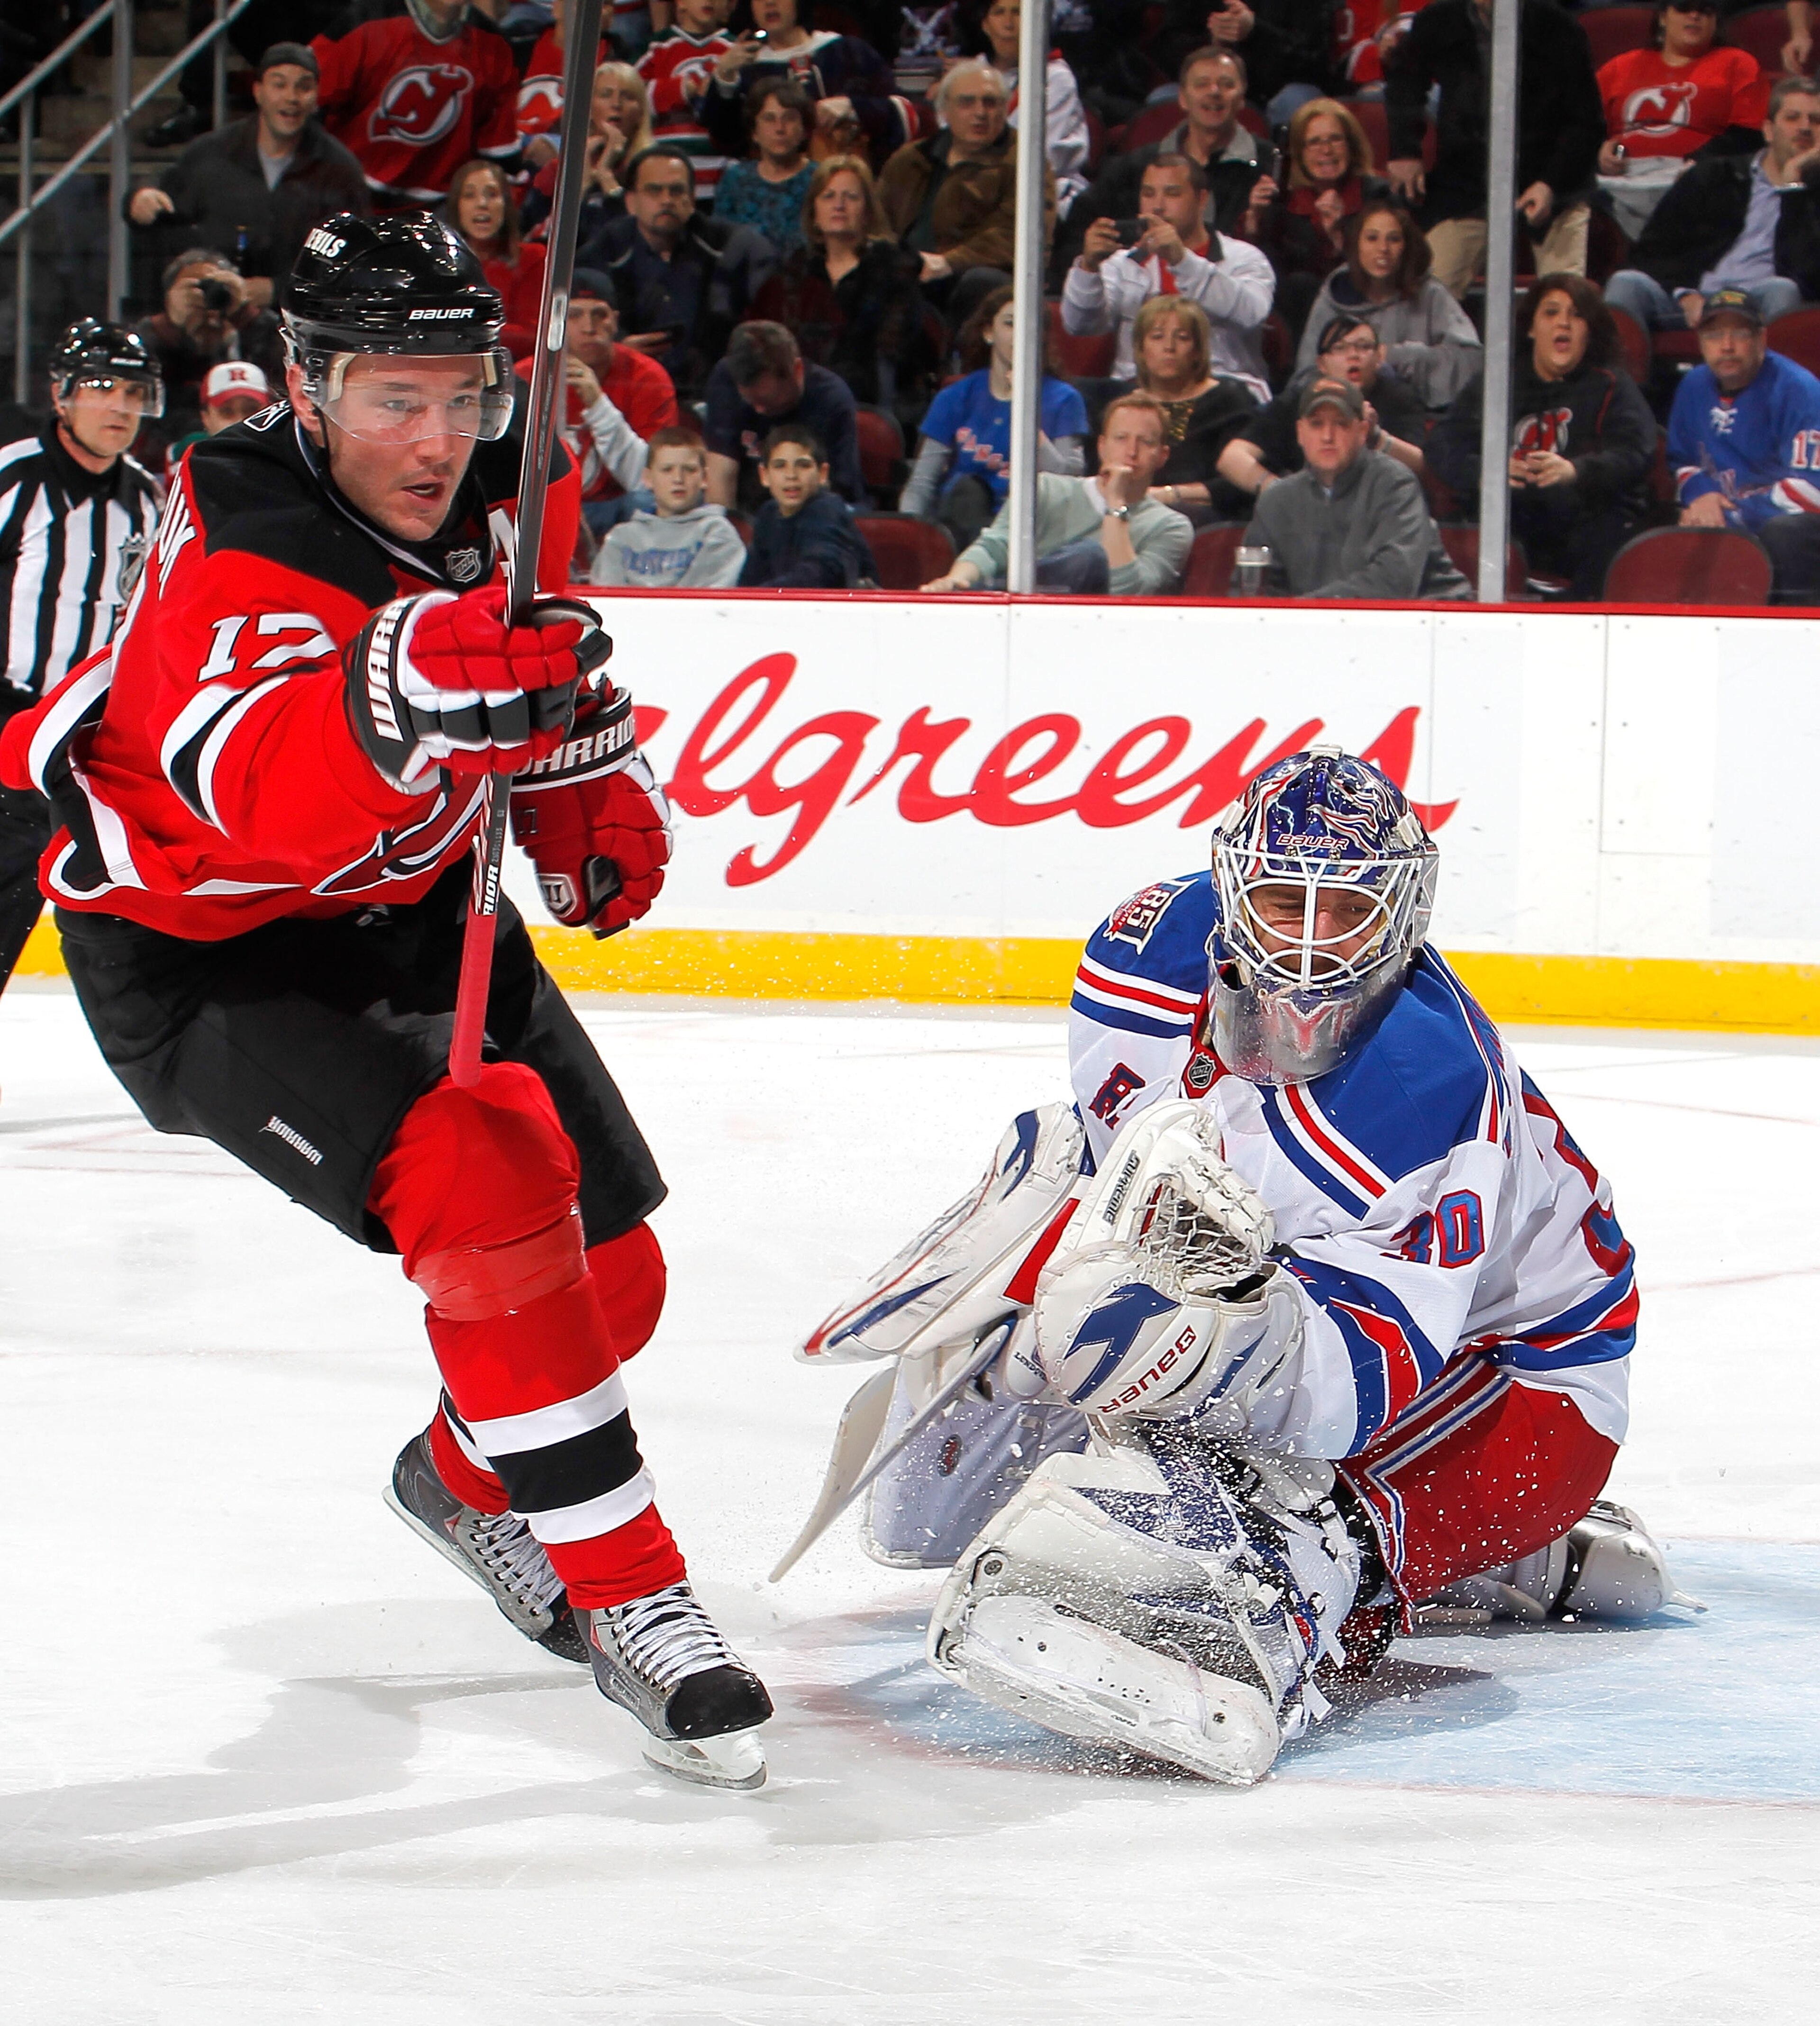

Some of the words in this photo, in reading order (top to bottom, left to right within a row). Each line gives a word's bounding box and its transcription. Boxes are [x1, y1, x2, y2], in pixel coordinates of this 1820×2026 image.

[304, 228, 346, 257] EVILS
[198, 613, 337, 682] 17
[265, 1115, 323, 1165] WARRIOR
[1379, 1189, 1485, 1269] 30
